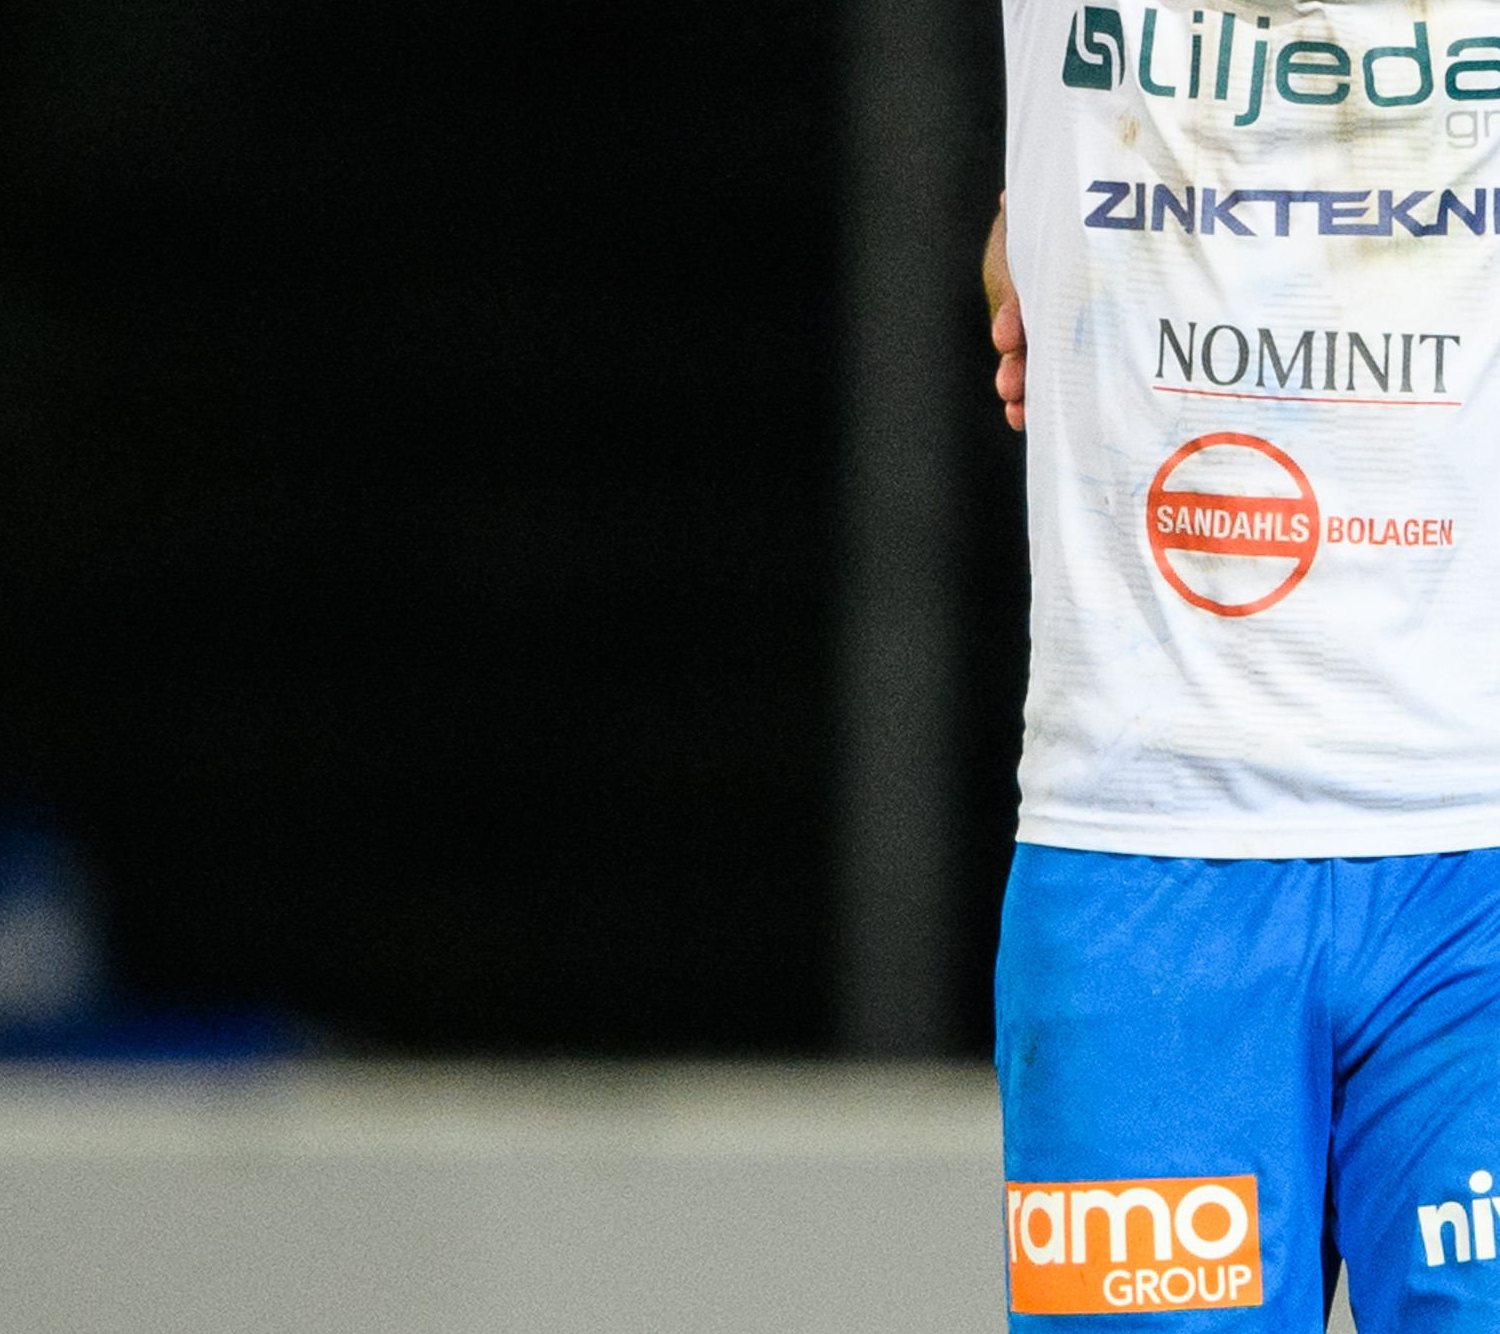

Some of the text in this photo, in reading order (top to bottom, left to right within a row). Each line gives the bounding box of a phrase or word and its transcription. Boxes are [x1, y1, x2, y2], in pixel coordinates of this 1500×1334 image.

[1155, 317, 1461, 394] NOMINIT
[1157, 505, 1454, 547] SANDAHLS BOLAGEN
[1102, 1265, 1253, 1307] GROUP
